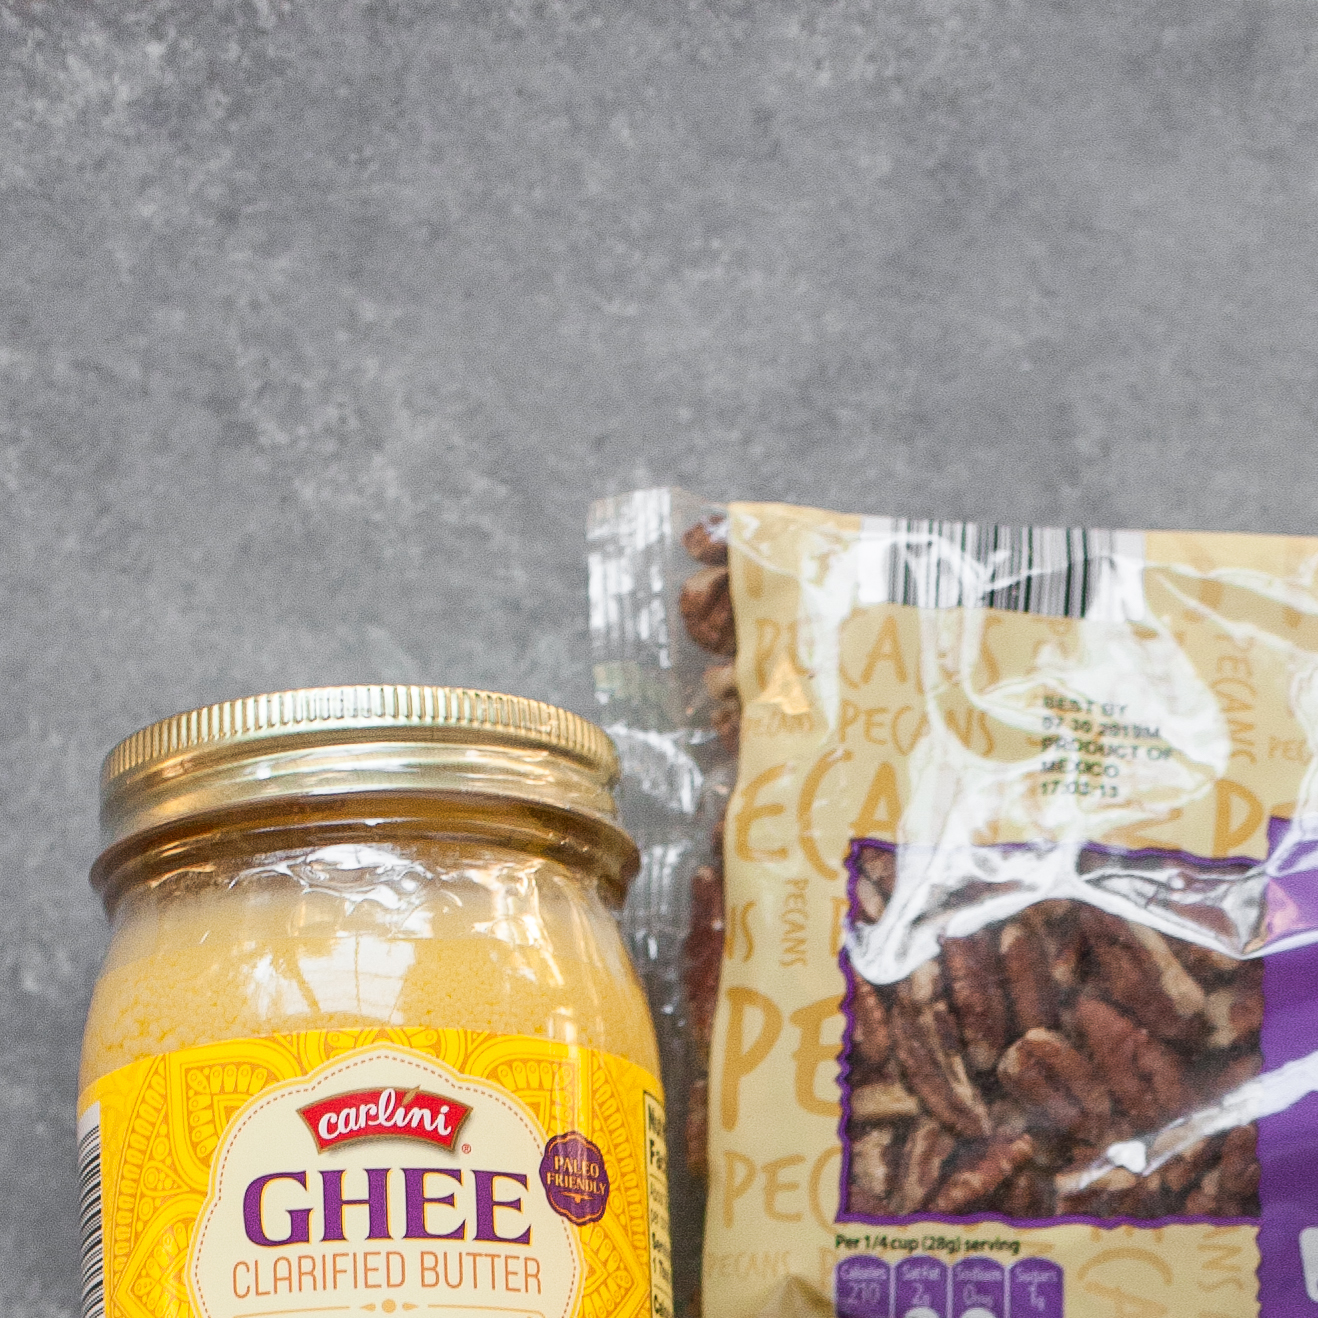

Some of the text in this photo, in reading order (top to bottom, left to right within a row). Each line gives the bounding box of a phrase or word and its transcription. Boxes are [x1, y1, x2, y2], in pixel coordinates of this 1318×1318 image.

[1041, 735, 1139, 758] PRODUCT
[318, 1086, 452, 1138] carlini
[554, 1156, 599, 1178] PALEO
[546, 1172, 606, 1195] FRIENDLY
[241, 1168, 534, 1248] GHEE
[835, 1234, 1021, 1255] Per 1/4 cup (28g) serving
[232, 1251, 542, 1299] CLARIFIED BUTTER
